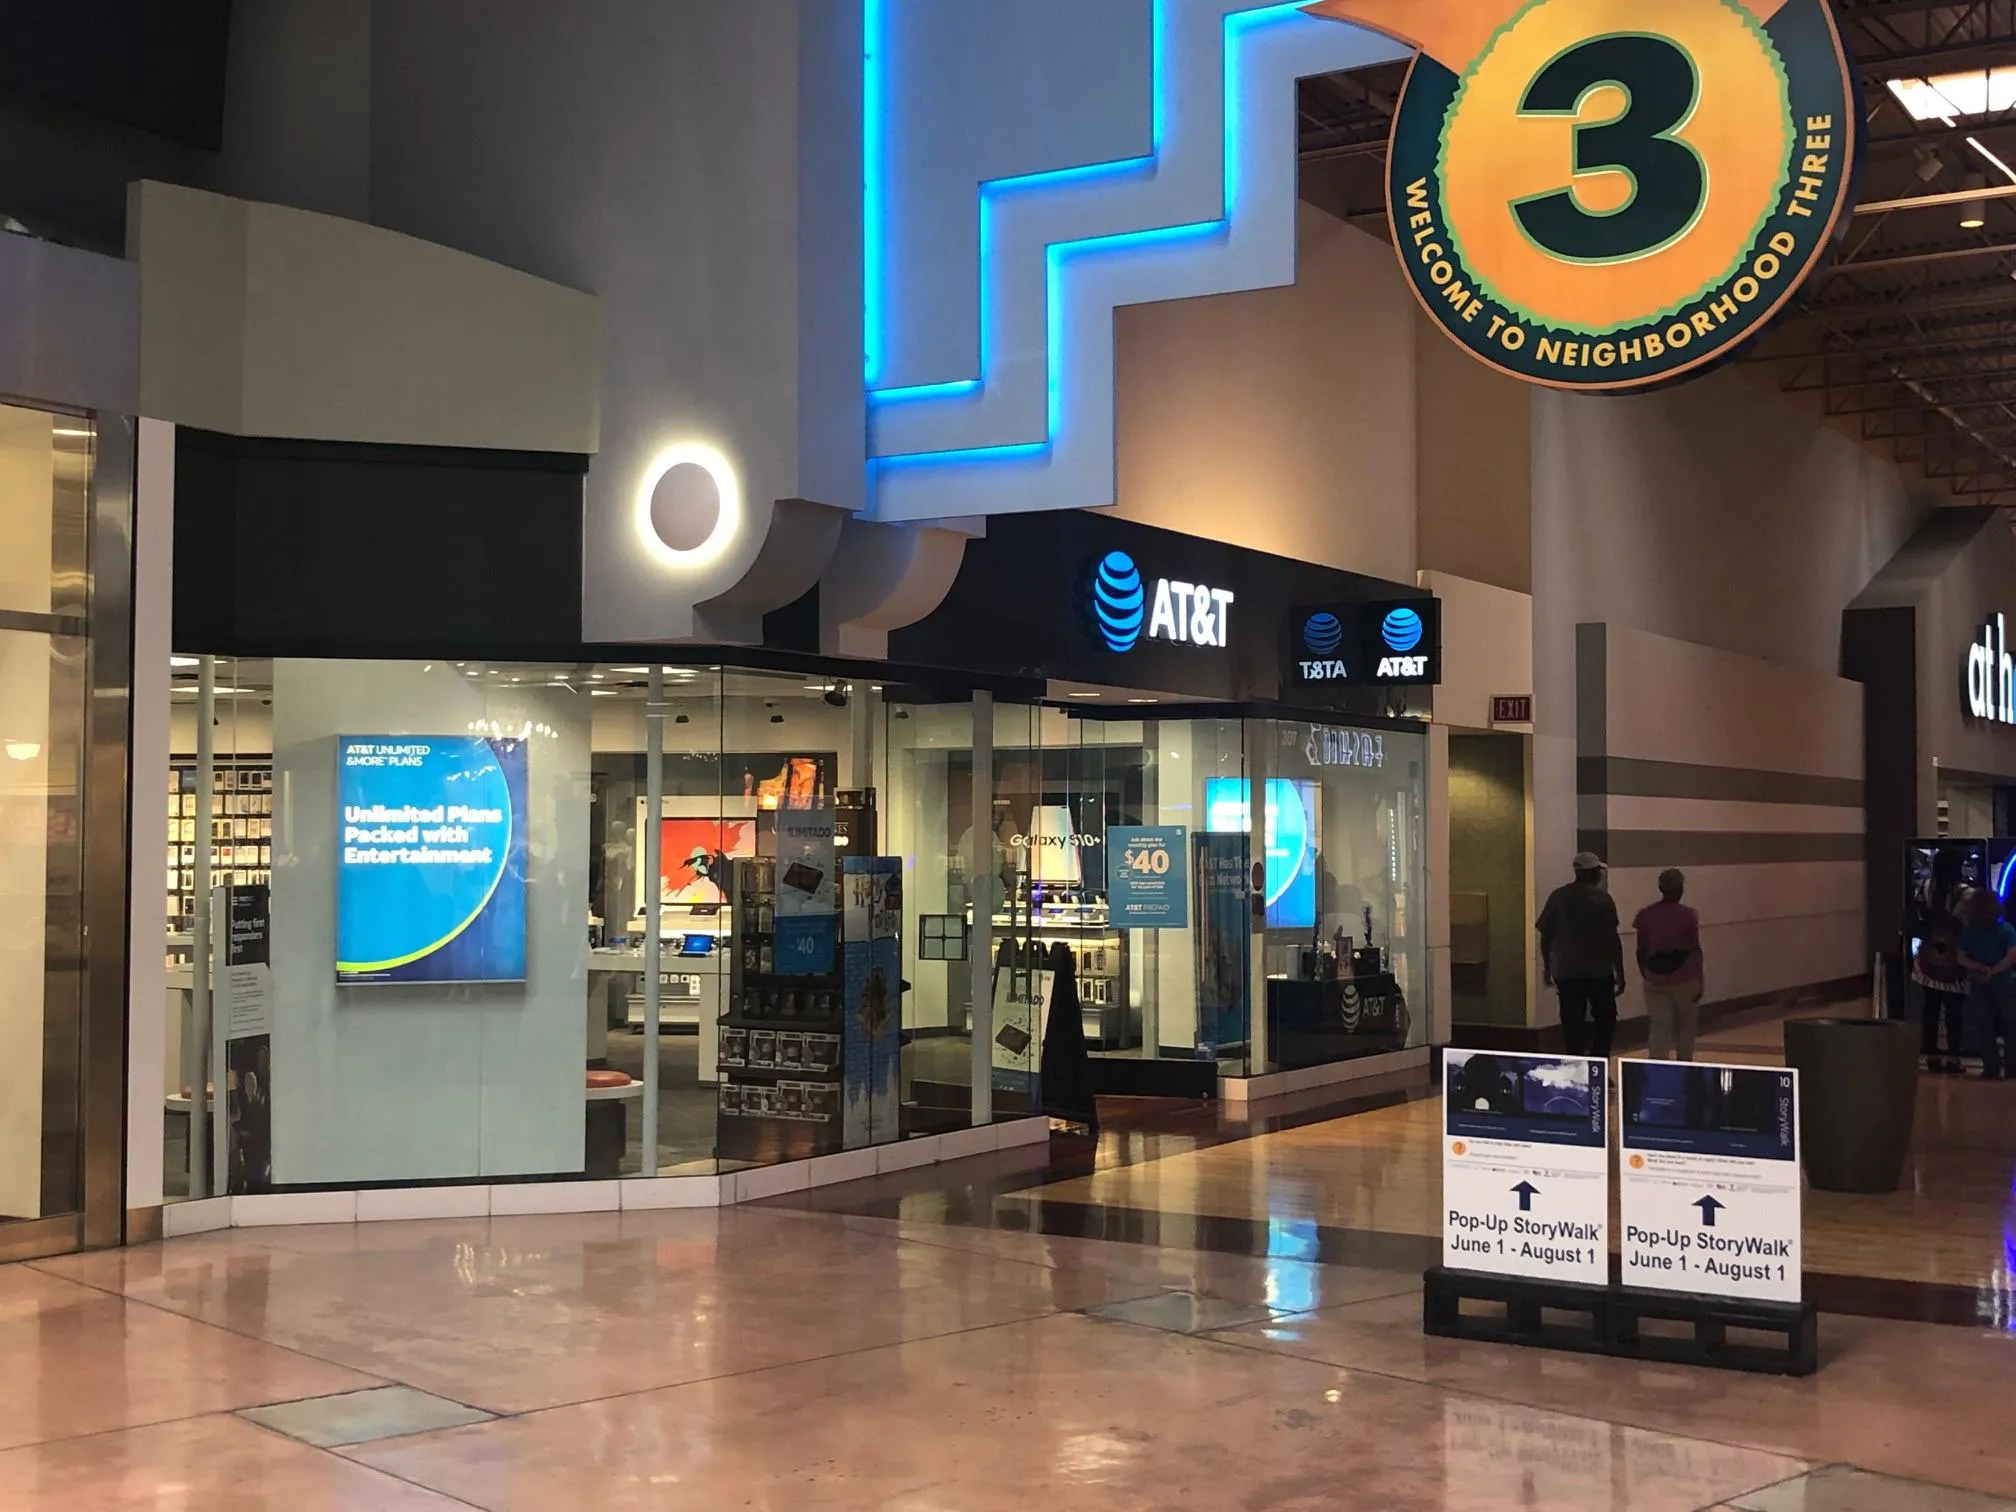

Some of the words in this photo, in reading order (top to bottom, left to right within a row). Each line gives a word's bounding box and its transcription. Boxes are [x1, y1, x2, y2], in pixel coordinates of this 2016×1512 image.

[1508, 31, 1710, 266] 3
[1406, 177, 1483, 323] WELCOME
[1486, 316, 1525, 351] TO
[1536, 231, 1795, 367] NEIGHBORHOOD
[1786, 114, 1831, 218] THREE
[1149, 578, 1234, 647] AT&T
[1376, 656, 1428, 677] AT&T
[1499, 699, 1528, 719] EXIT
[346, 745, 374, 755] AT&T
[376, 745, 430, 756] UNLIMITED
[388, 756, 423, 766] PLANS
[344, 805, 444, 823] Unlimited
[447, 805, 503, 823] Plans
[344, 826, 419, 843] Packed
[422, 825, 469, 843] with
[1009, 833, 1066, 849] Galaxy
[344, 846, 493, 864] Entertainment
[1124, 849, 1169, 874] $40
[1362, 996, 1385, 1017] AT&T
[1779, 1076, 1790, 1088] 10
[1449, 1210, 1508, 1233] Pop-Up
[1626, 1225, 1691, 1250] Pop-Up
[1450, 1234, 1491, 1254] June
[1496, 1239, 1504, 1255] 1
[1520, 1241, 1582, 1264] August
[1587, 1249, 1595, 1264] 1
[1629, 1250, 1673, 1270] June
[1679, 1255, 1687, 1271] 1
[1704, 1257, 1771, 1281] August
[1777, 1265, 1785, 1281] 1
